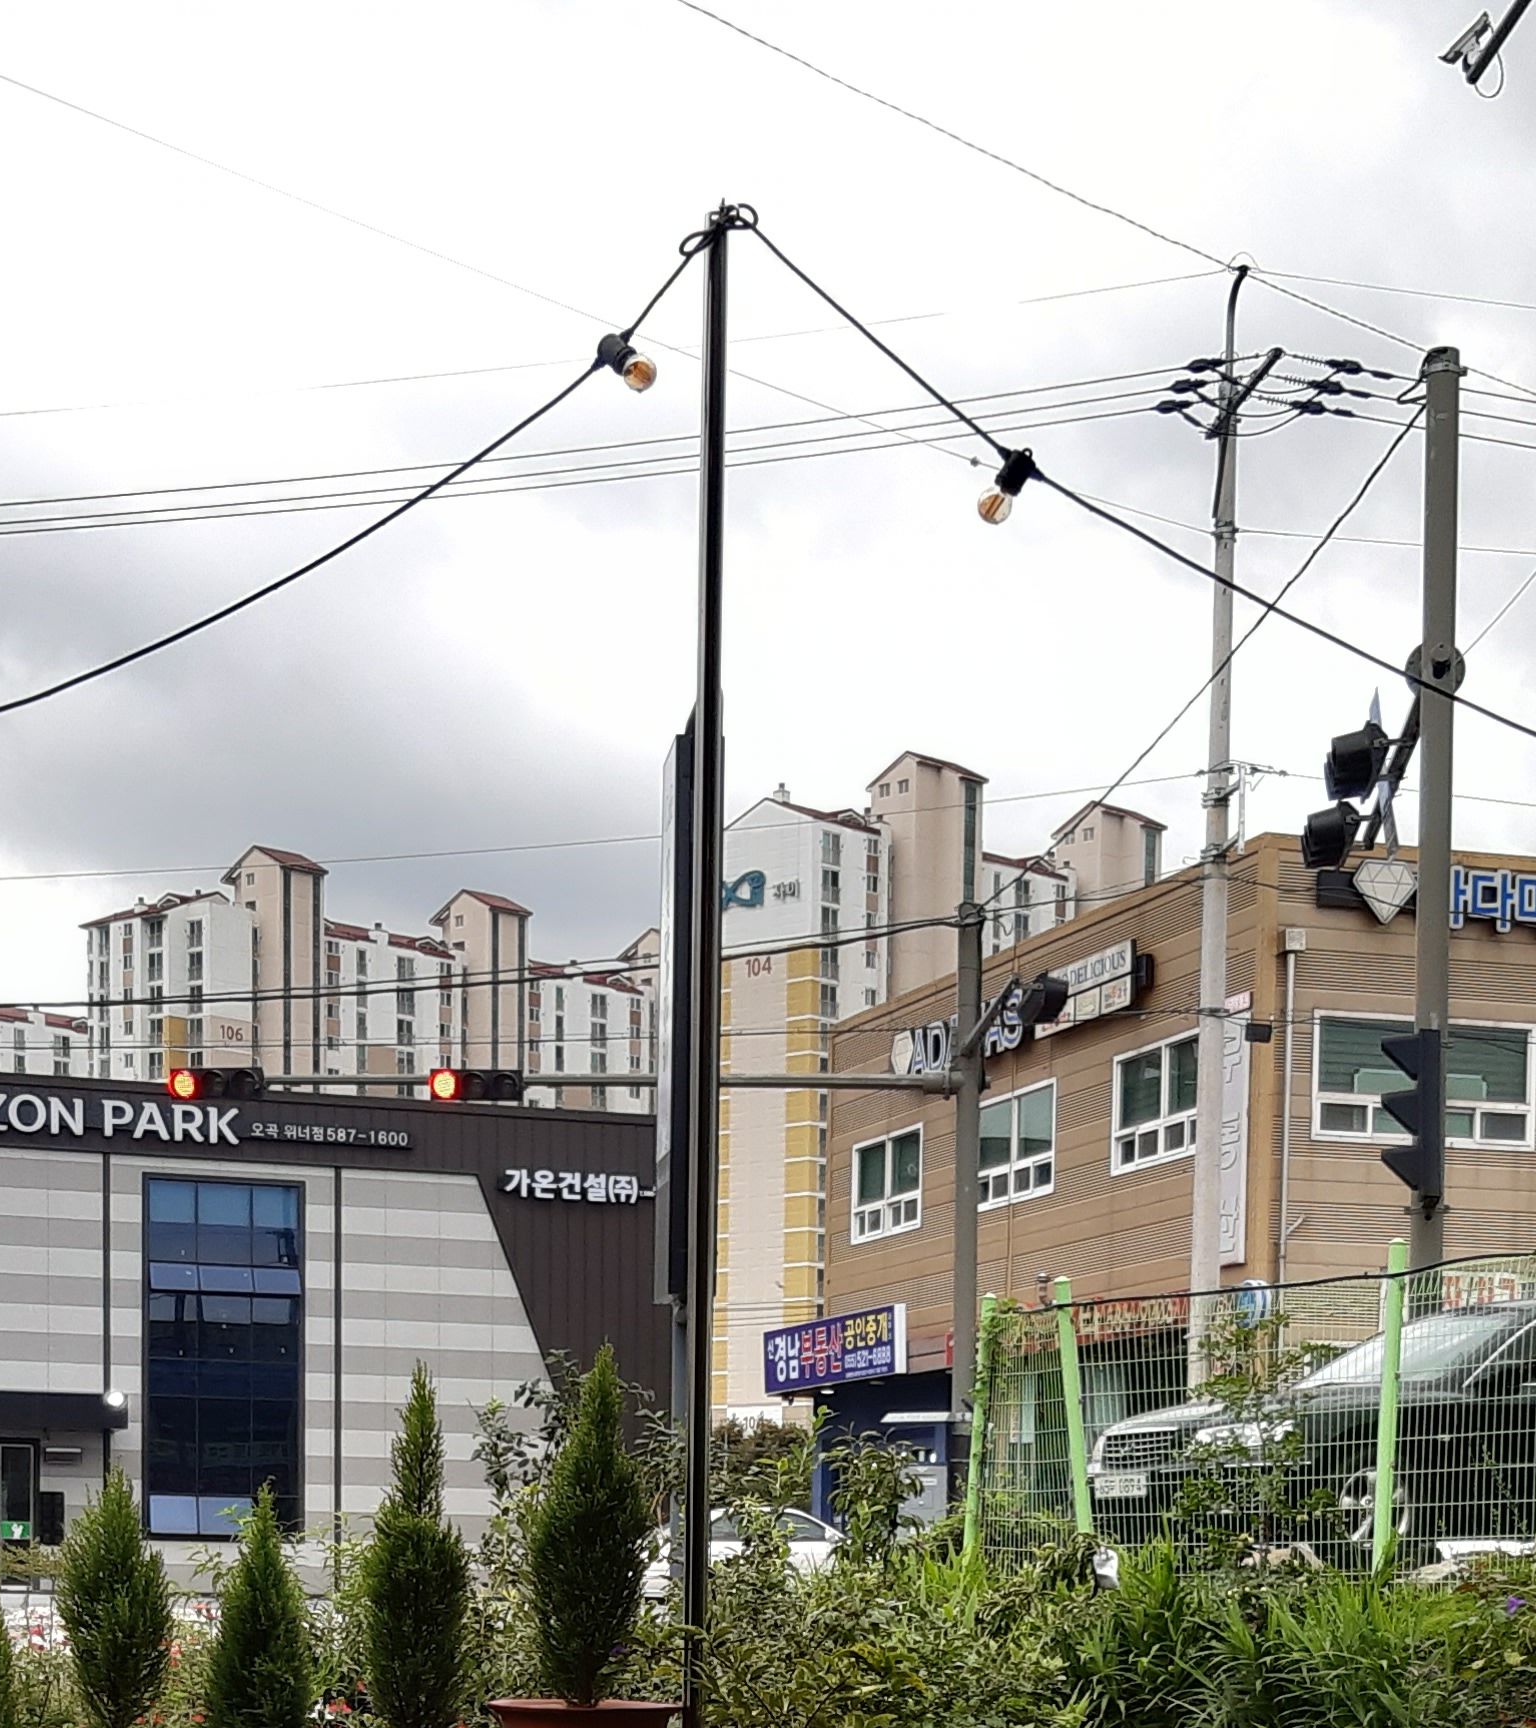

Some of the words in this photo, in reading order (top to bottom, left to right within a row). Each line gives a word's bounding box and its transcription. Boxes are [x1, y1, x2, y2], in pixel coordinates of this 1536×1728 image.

[744, 956, 773, 979] 104
[1069, 949, 1128, 987] DELICIOUS
[220, 1024, 244, 1042] 106
[913, 988, 1024, 1075] ADAS
[101, 1099, 240, 1146] PARK
[250, 1122, 280, 1139] 오곡
[326, 1128, 409, 1146] 587-1600
[503, 1168, 639, 1205] 가온건설(주)
